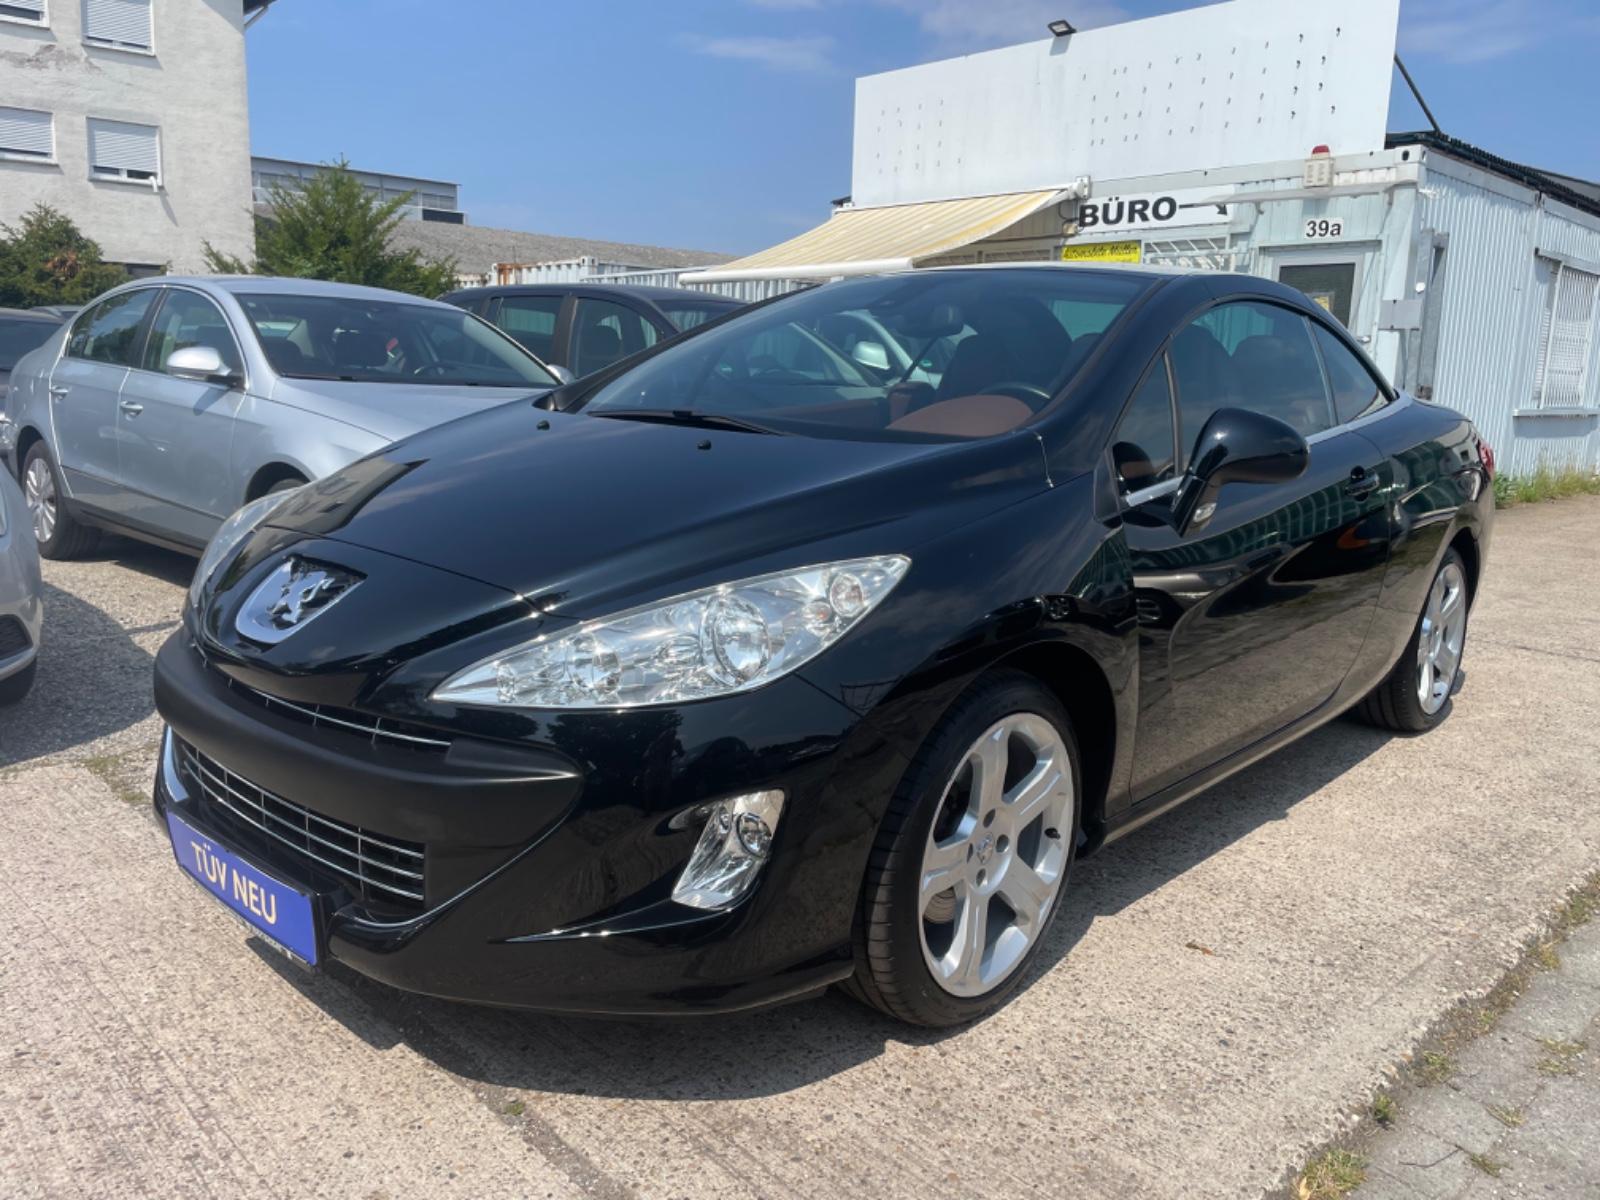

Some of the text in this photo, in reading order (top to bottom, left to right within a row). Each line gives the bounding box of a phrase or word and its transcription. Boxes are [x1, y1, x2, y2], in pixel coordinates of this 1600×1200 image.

[1079, 196, 1177, 227] BÜRO
[1306, 220, 1341, 237] 39a
[191, 841, 276, 924] TÜV NEU
